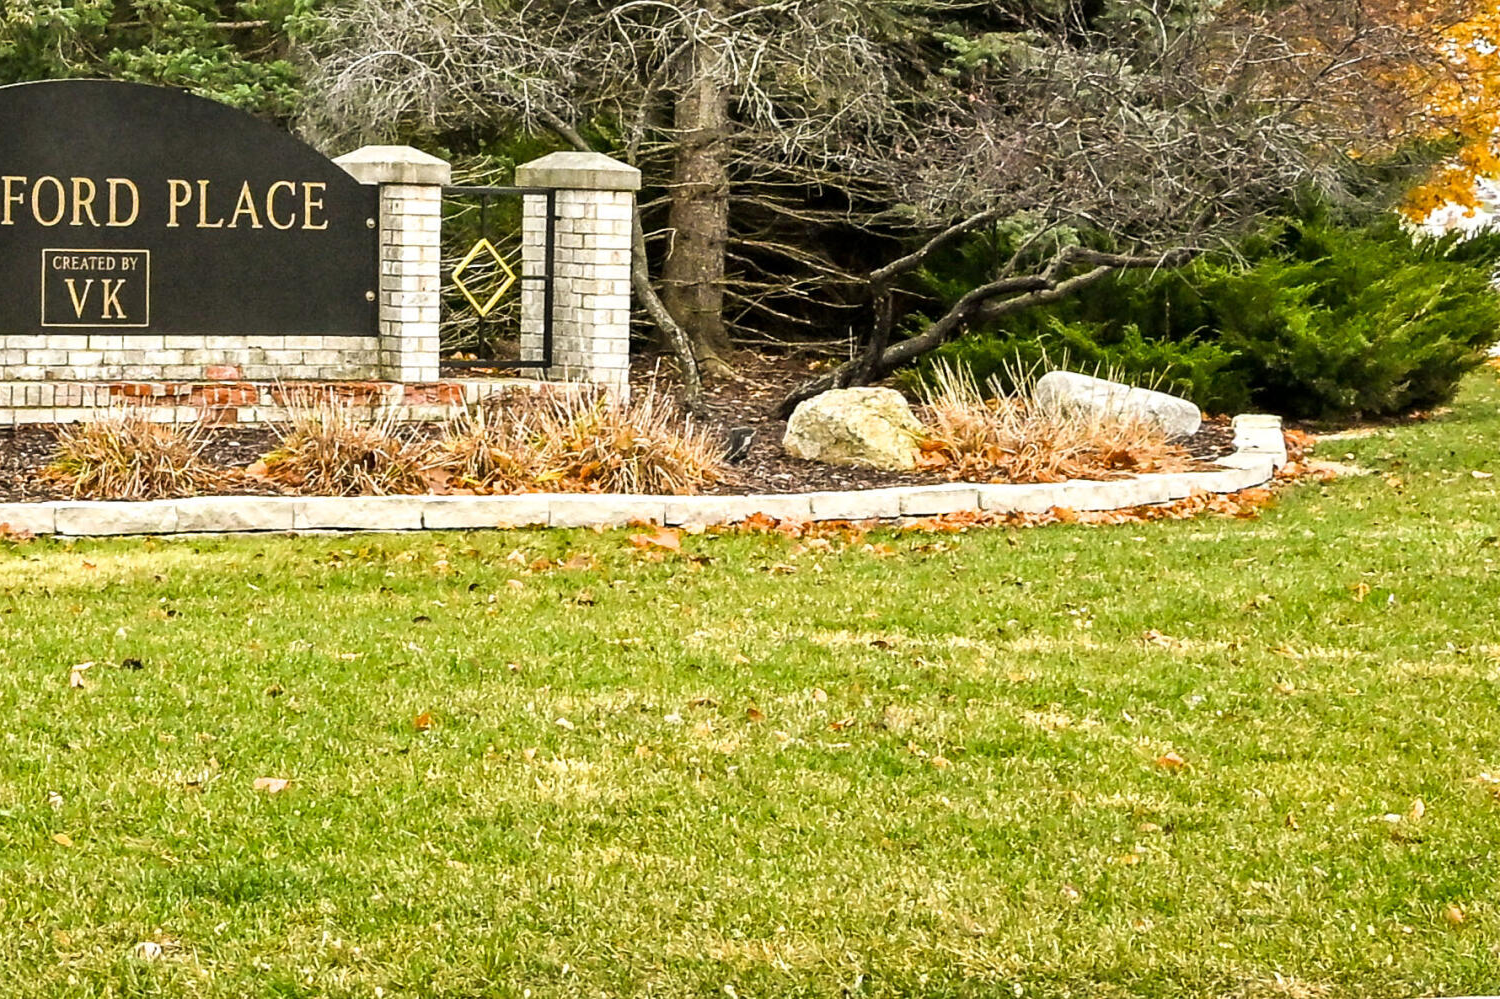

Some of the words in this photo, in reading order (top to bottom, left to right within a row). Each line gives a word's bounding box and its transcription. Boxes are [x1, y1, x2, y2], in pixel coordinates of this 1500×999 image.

[167, 179, 329, 230] PLACE
[52, 256, 116, 271] CREATED
[121, 256, 138, 271] BY
[64, 278, 127, 319] VK
